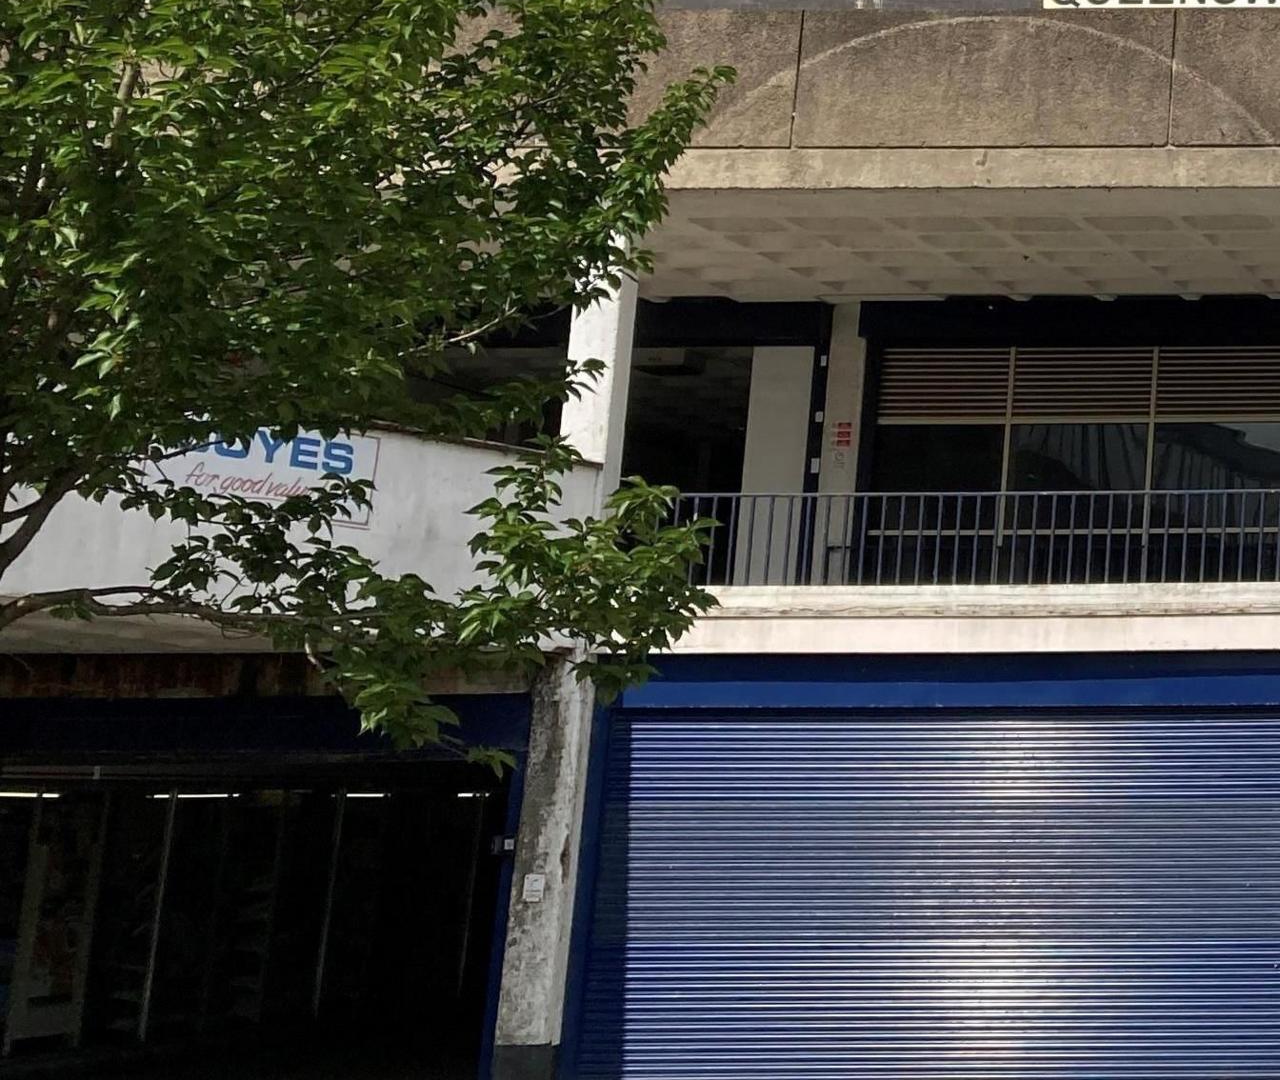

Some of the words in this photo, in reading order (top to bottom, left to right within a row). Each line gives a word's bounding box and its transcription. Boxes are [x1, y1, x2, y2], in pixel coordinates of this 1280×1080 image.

[194, 429, 355, 475] OYES
[184, 461, 217, 486] for
[219, 472, 271, 494] good
